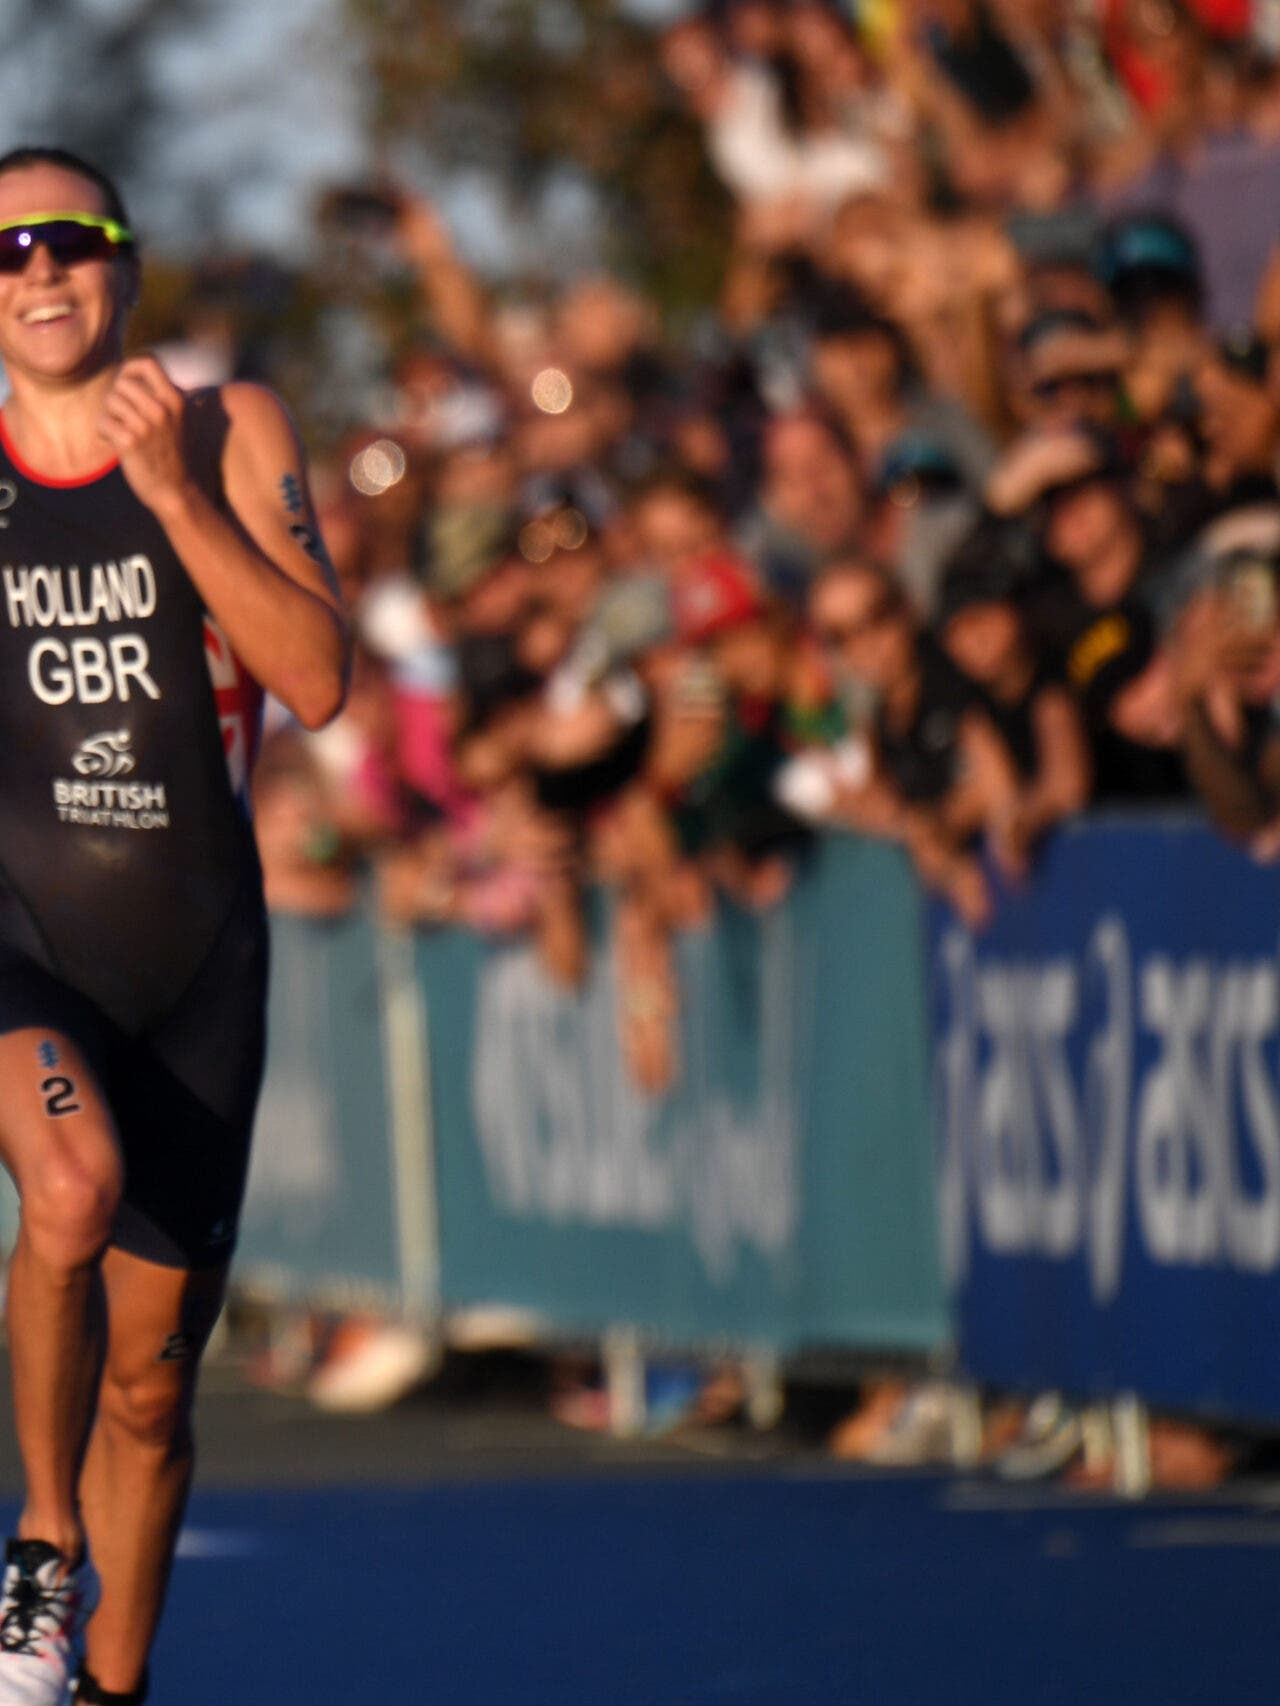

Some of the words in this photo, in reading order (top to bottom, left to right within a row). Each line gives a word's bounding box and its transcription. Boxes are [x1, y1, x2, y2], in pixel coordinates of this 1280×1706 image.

[2, 554, 158, 628] HOLLAND
[28, 634, 161, 706] GBR
[53, 778, 166, 809] BRITISH
[58, 805, 170, 829] TRIATHLON
[41, 1076, 80, 1117] 2
